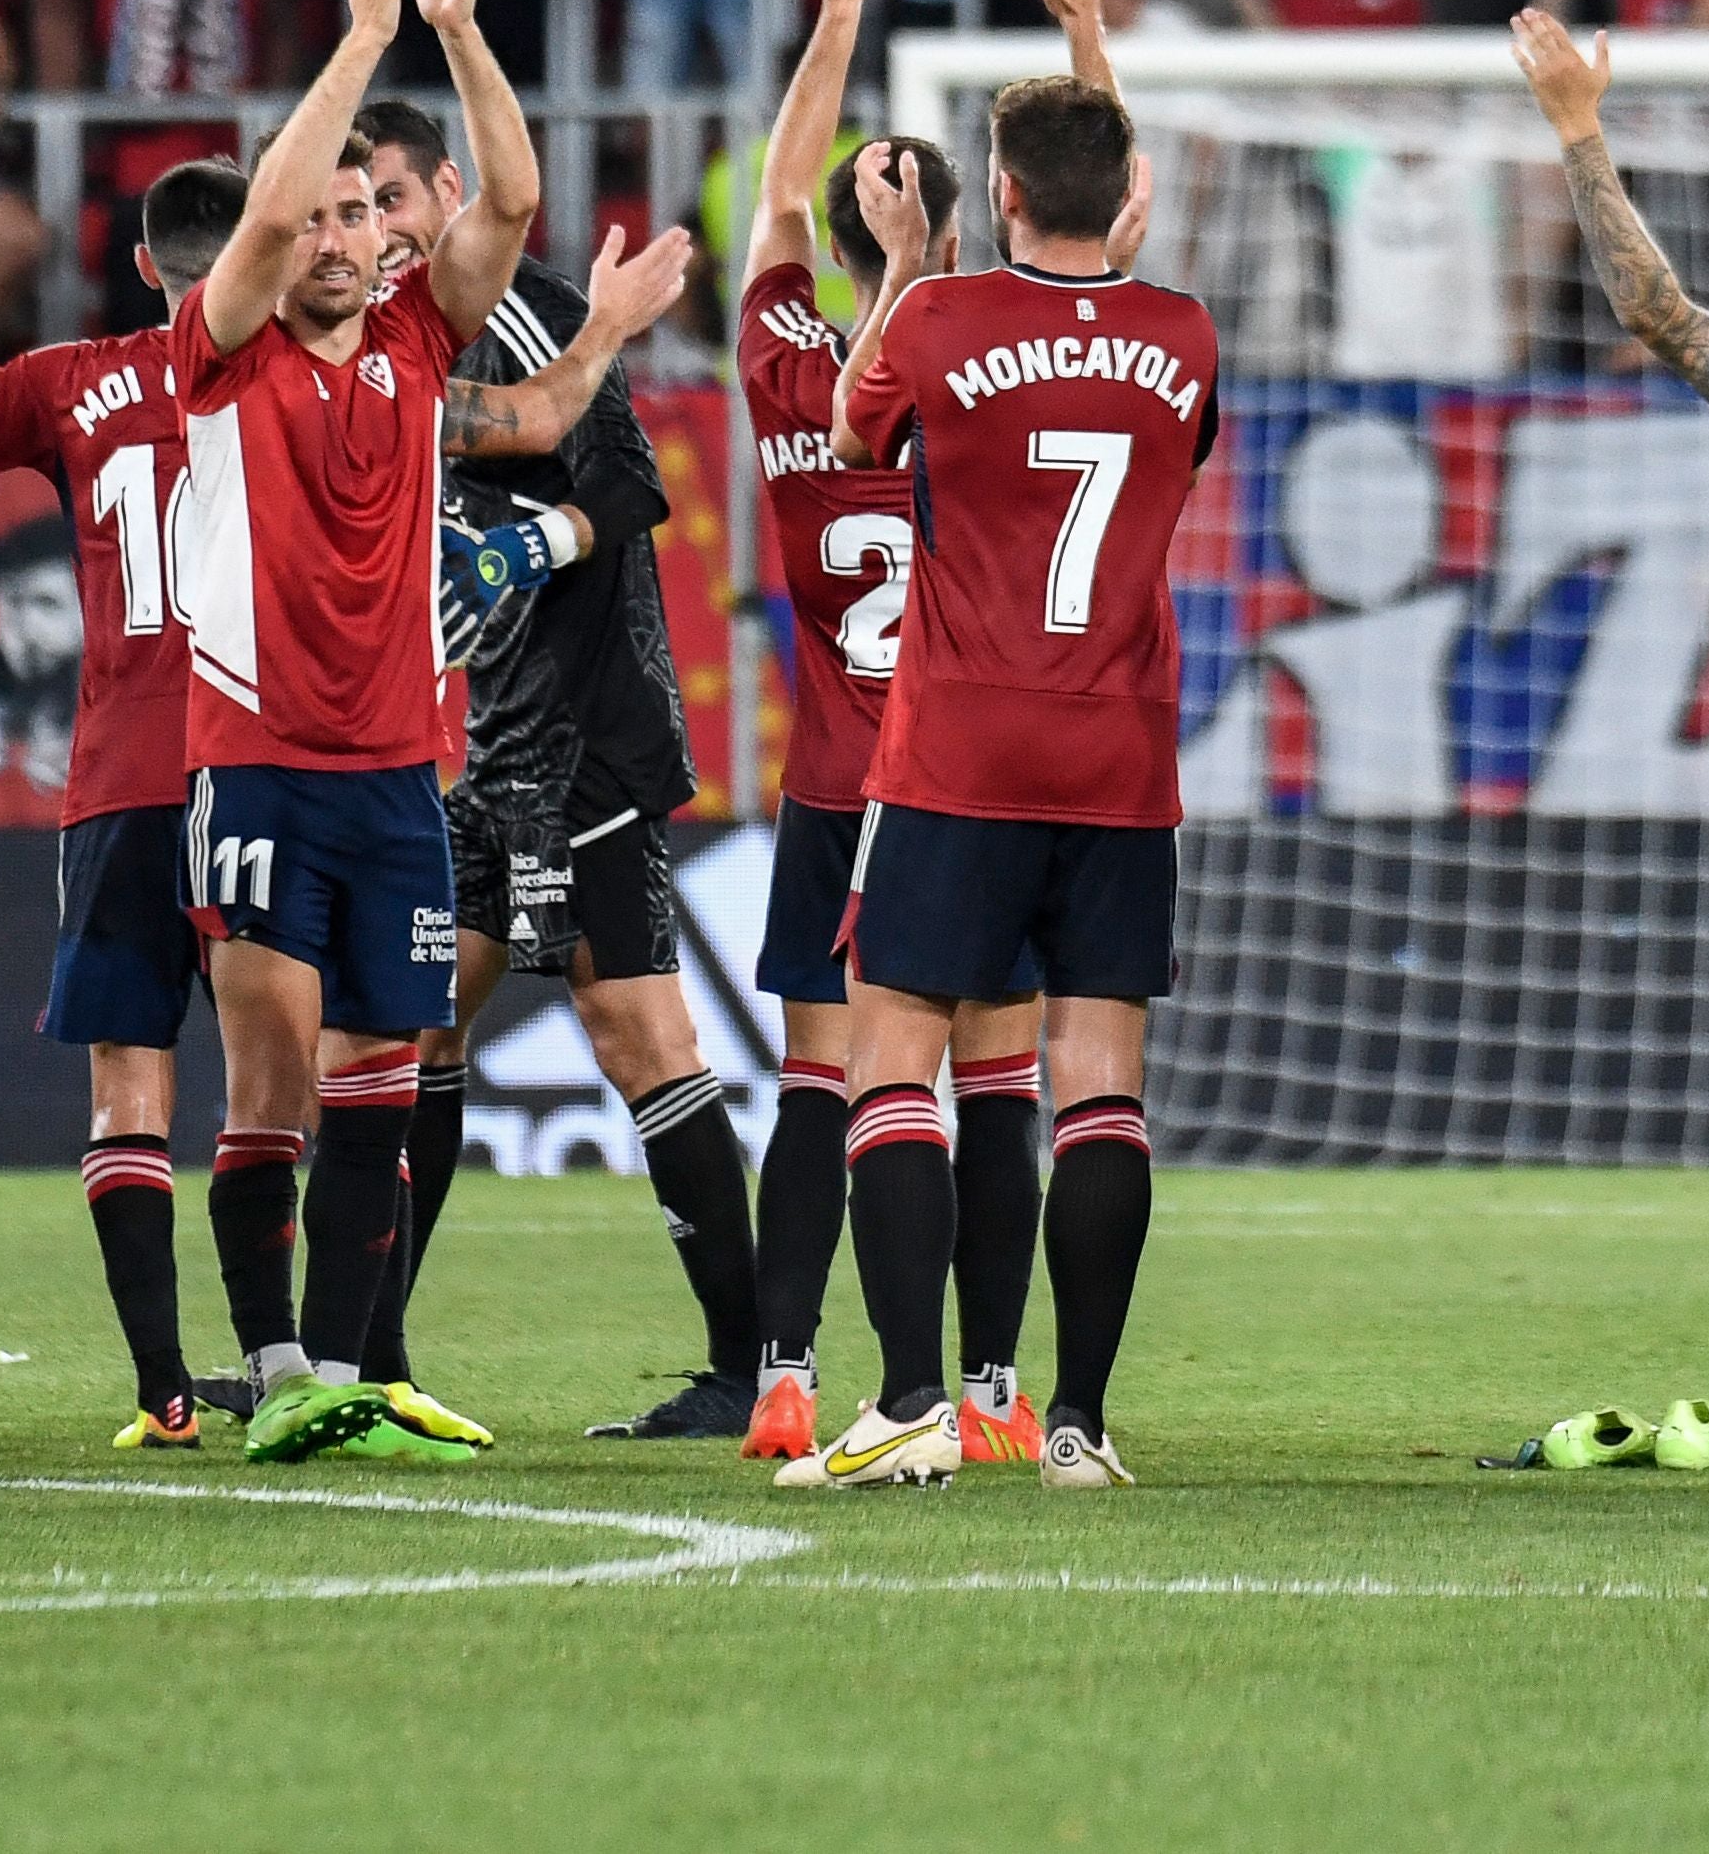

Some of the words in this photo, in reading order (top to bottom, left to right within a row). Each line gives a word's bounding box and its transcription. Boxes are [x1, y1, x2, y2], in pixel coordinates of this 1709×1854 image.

[72, 364, 143, 438] MOI
[944, 336, 1201, 423] MONCAYOLA
[1027, 429, 1134, 636] 7
[212, 835, 275, 912] 11
[410, 944, 429, 963] de
